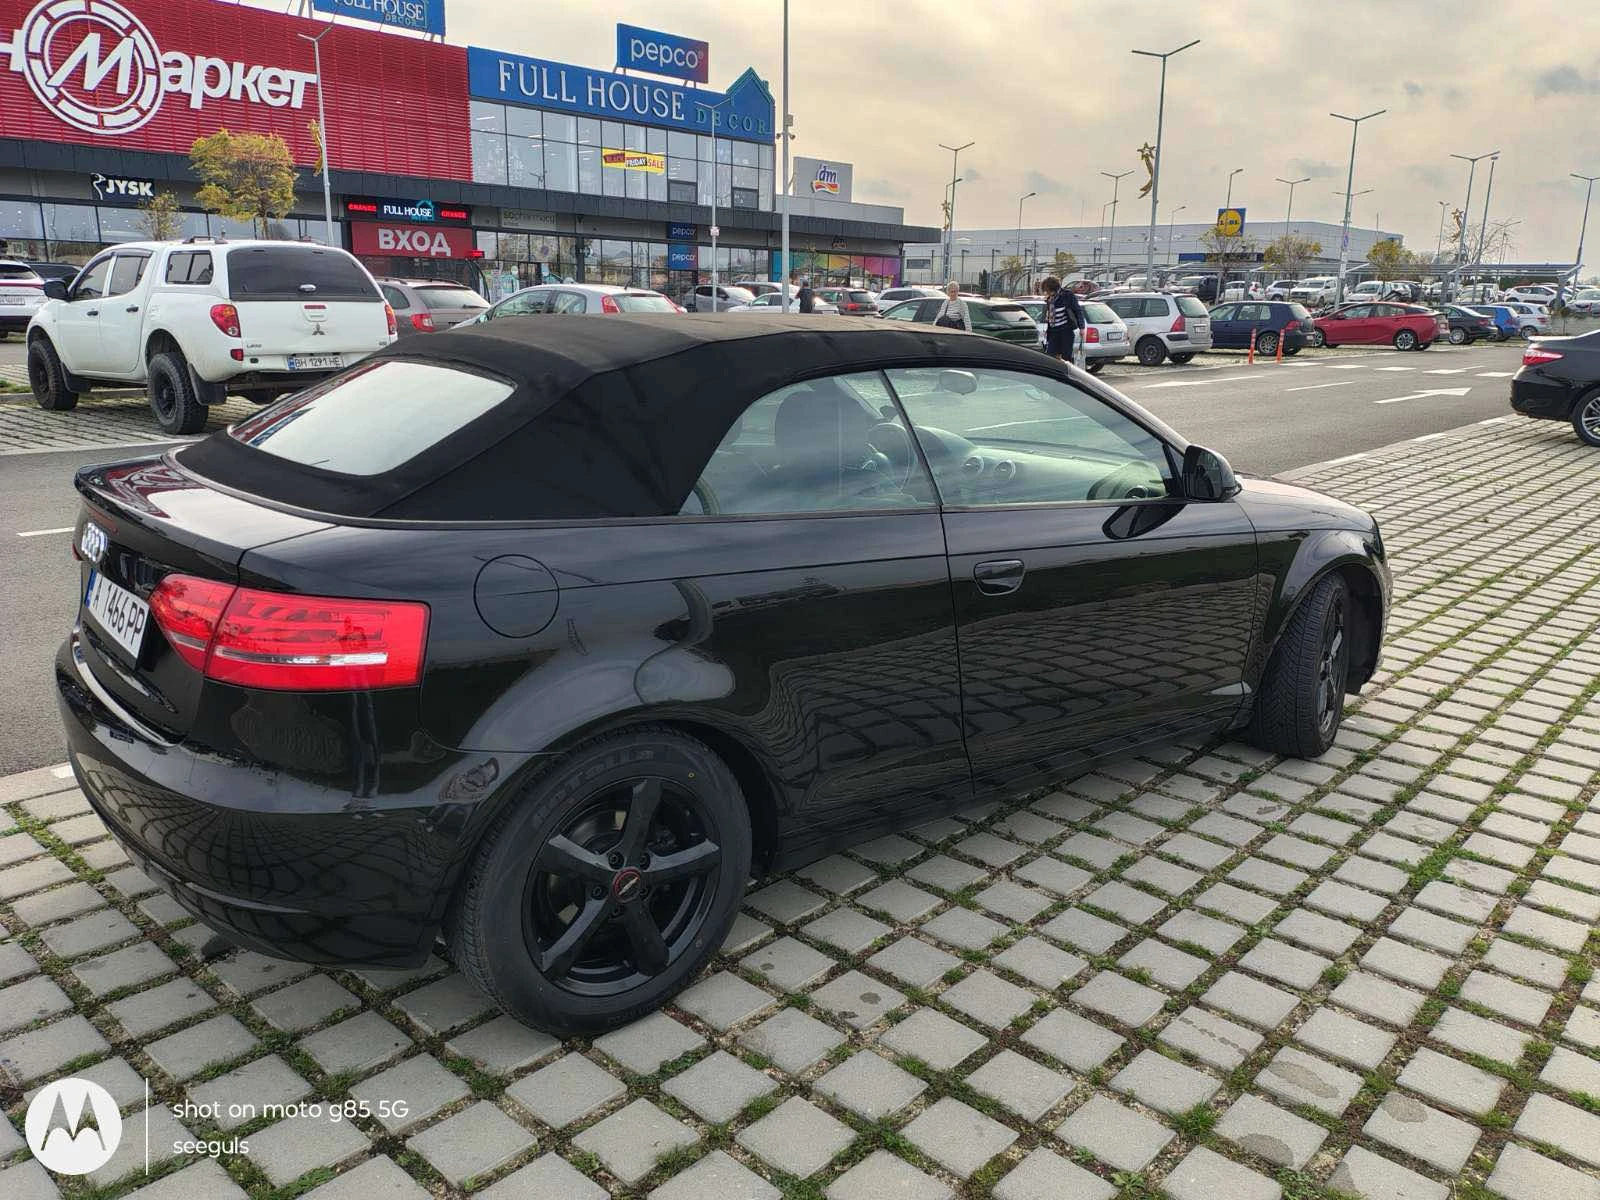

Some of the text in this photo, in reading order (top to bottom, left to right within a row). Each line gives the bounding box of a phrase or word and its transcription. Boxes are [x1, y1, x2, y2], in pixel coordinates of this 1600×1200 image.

[373, 0, 424, 20] HOUSE
[47, 33, 317, 109] Маркет
[499, 58, 766, 134] FULL HOUSE DECOR
[647, 159, 665, 169] SALE
[816, 164, 837, 183] dm
[106, 179, 154, 196] JYSK
[383, 205, 432, 217] FULL HOUSE
[378, 228, 452, 257] ВХОД
[671, 253, 696, 262] pepco
[309, 358, 327, 367] 1291
[103, 583, 129, 633] 1466
[123, 601, 145, 646] PP
